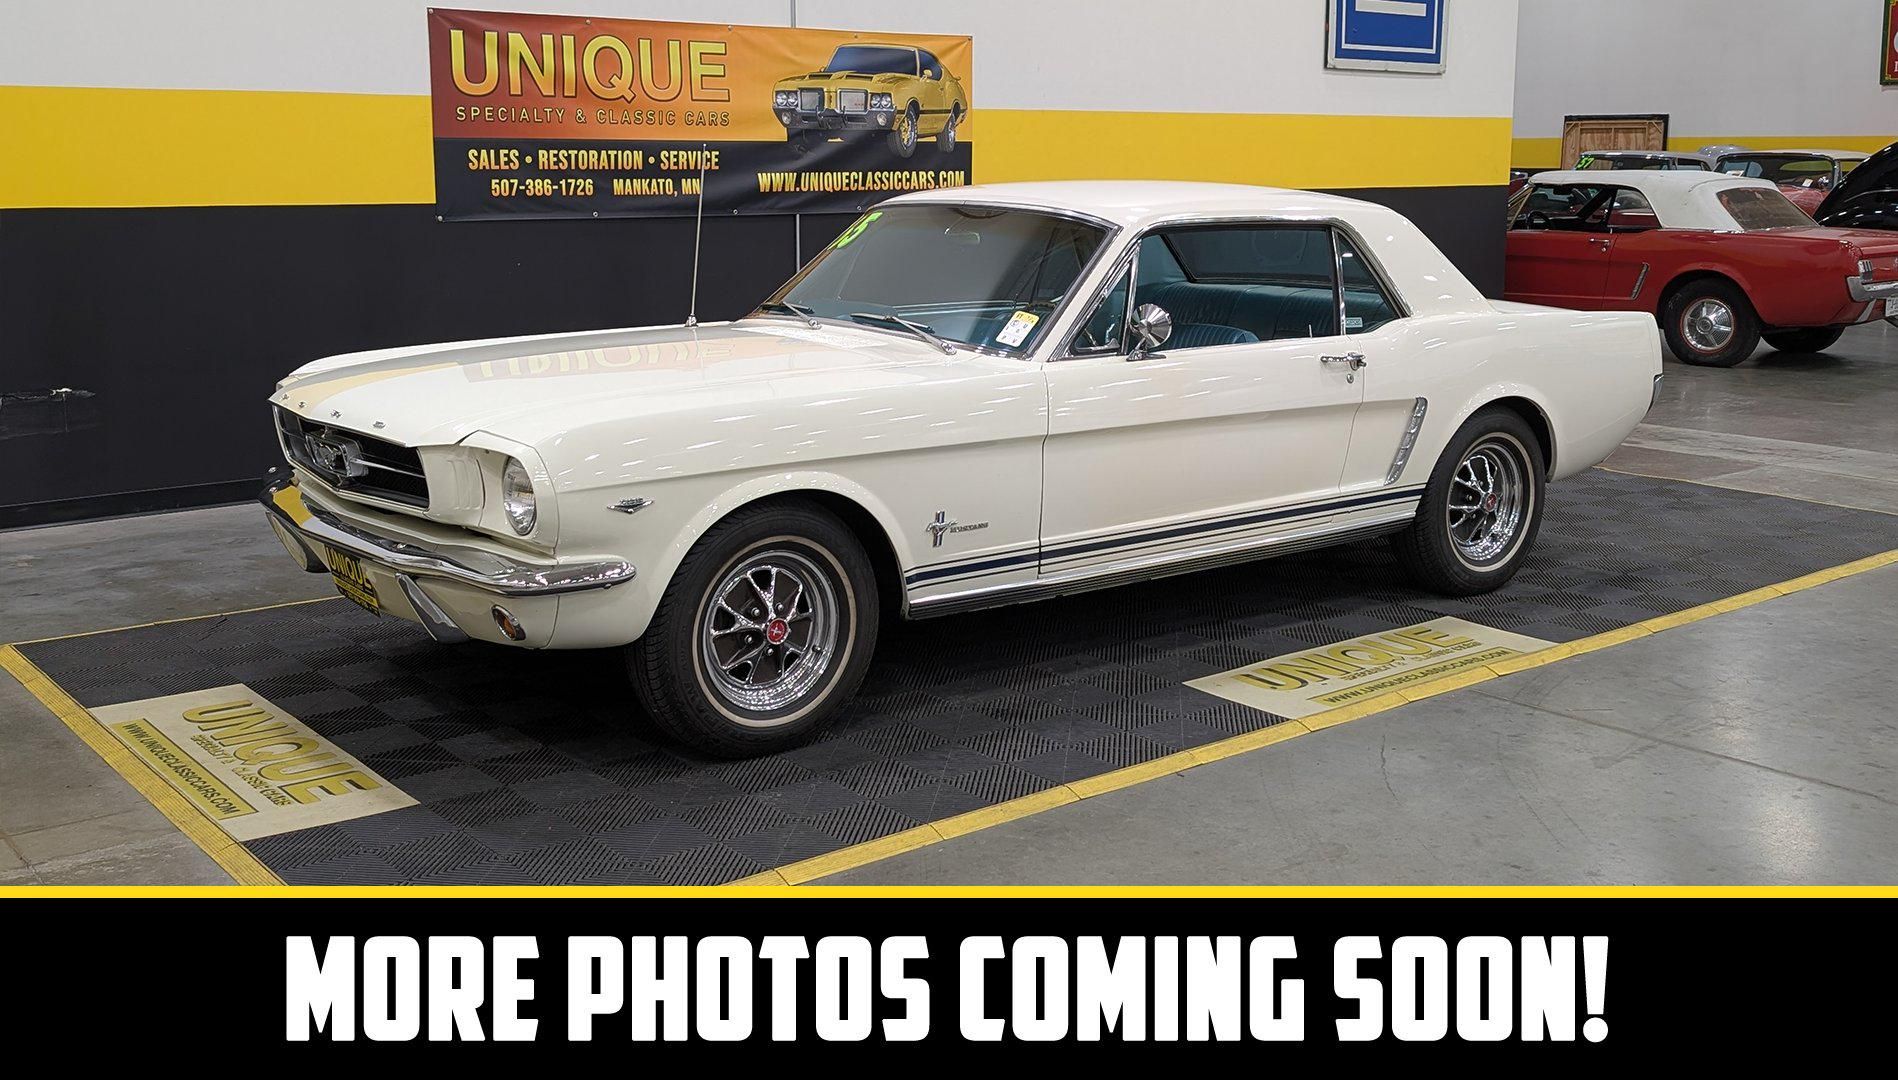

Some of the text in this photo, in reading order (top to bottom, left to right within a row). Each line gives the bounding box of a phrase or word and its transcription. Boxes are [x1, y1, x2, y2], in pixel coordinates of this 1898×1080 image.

[449, 28, 731, 103] UNIQUE
[455, 105, 731, 126] SPECIALTY & CLASSIC CARS
[467, 148, 720, 171] SALES RESTORATION SERVICE
[490, 178, 594, 197] 507-386-1726
[612, 178, 701, 198] MANKATO, MN
[757, 170, 965, 193] WWW.UNIQUECLASSICCARS.COM
[949, 521, 989, 534] MUSTANG
[1232, 626, 1474, 691] UNIQUE
[181, 699, 382, 805] UNIQUE
[123, 723, 242, 814] WWW.UNIQUECLASSICCARS.COM
